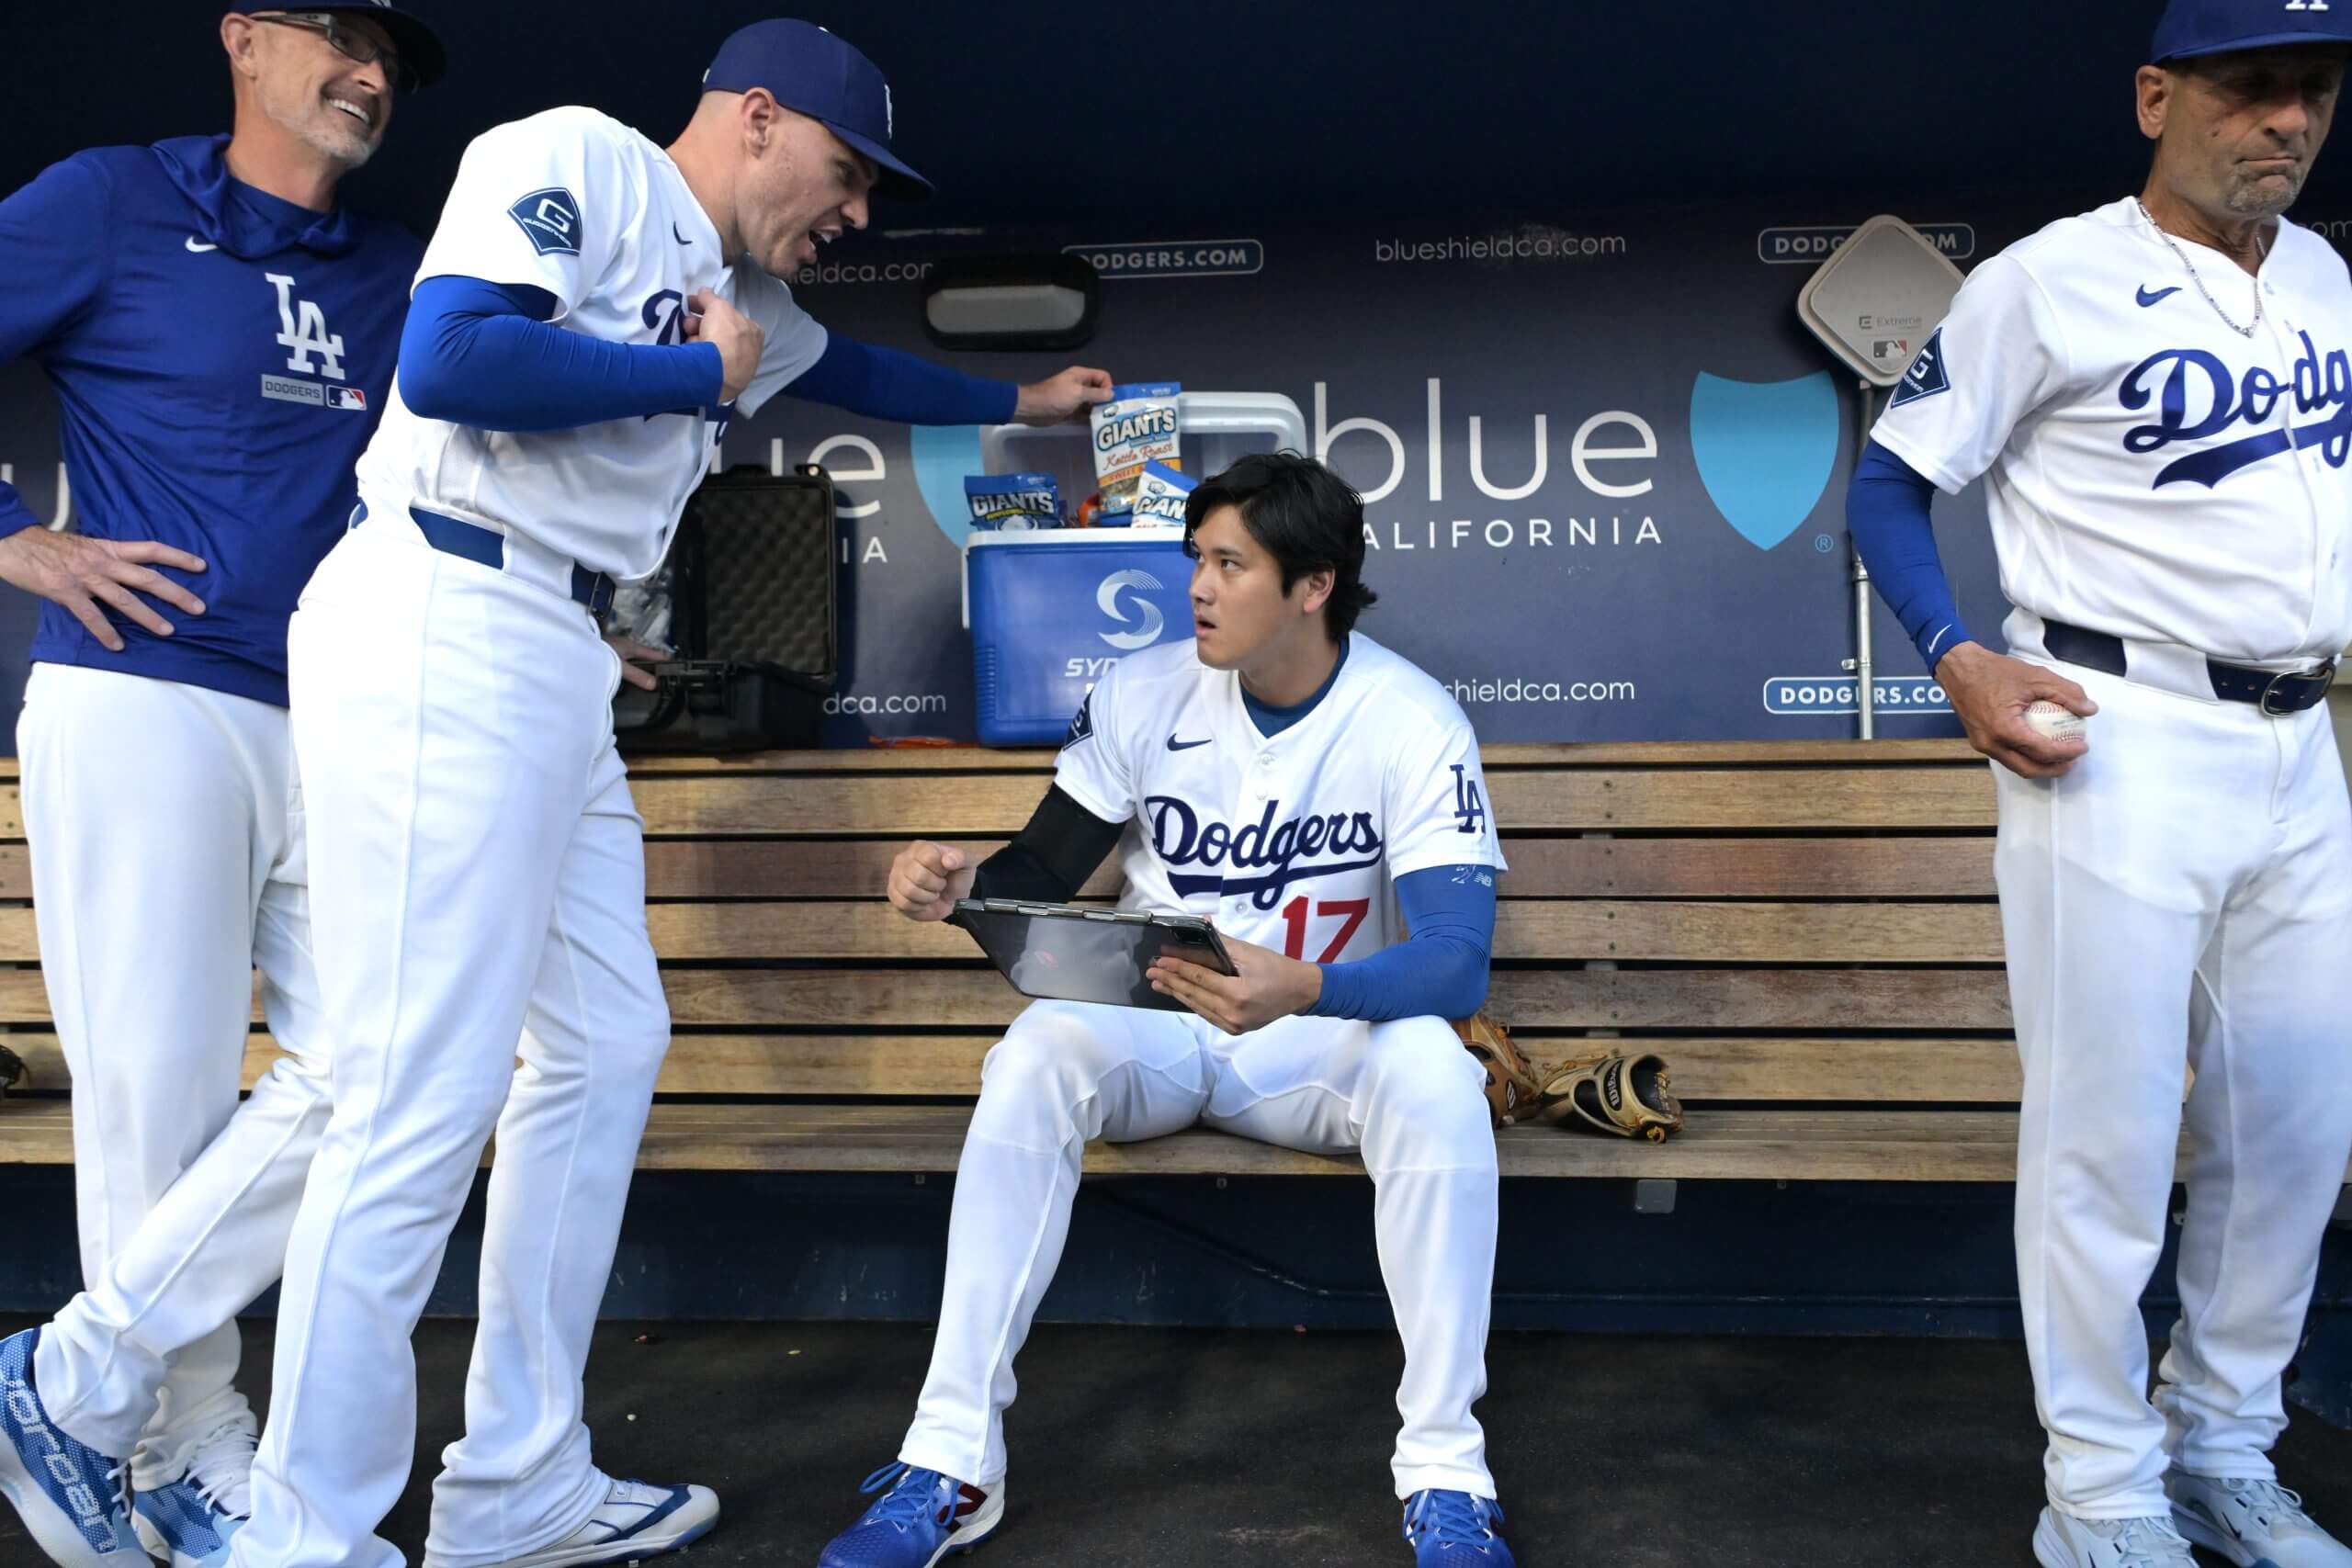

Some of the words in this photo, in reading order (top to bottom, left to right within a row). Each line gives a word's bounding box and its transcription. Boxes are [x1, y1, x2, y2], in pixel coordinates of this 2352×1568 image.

[1080, 249, 1248, 270] ODGERS.COM
[1375, 235, 1626, 262] blueshieldca.com
[265, 272, 346, 380] LA
[264, 379, 322, 400] DODGERS
[2118, 329, 2352, 469] Dodg
[1097, 408, 1176, 451] GIANTS
[1314, 377, 1658, 505] blue
[971, 491, 1056, 518] GIANTS
[1132, 496, 1187, 521] GIAN
[1362, 515, 1662, 551] ALIFORNIA
[823, 692, 946, 714] dca.com
[1443, 678, 1635, 703] hieldca.com
[1781, 686, 1951, 705] DODGRS.CO
[1449, 763, 1487, 835] LA
[1145, 795, 1384, 911] Dodgers
[1282, 895, 1370, 964] 17
